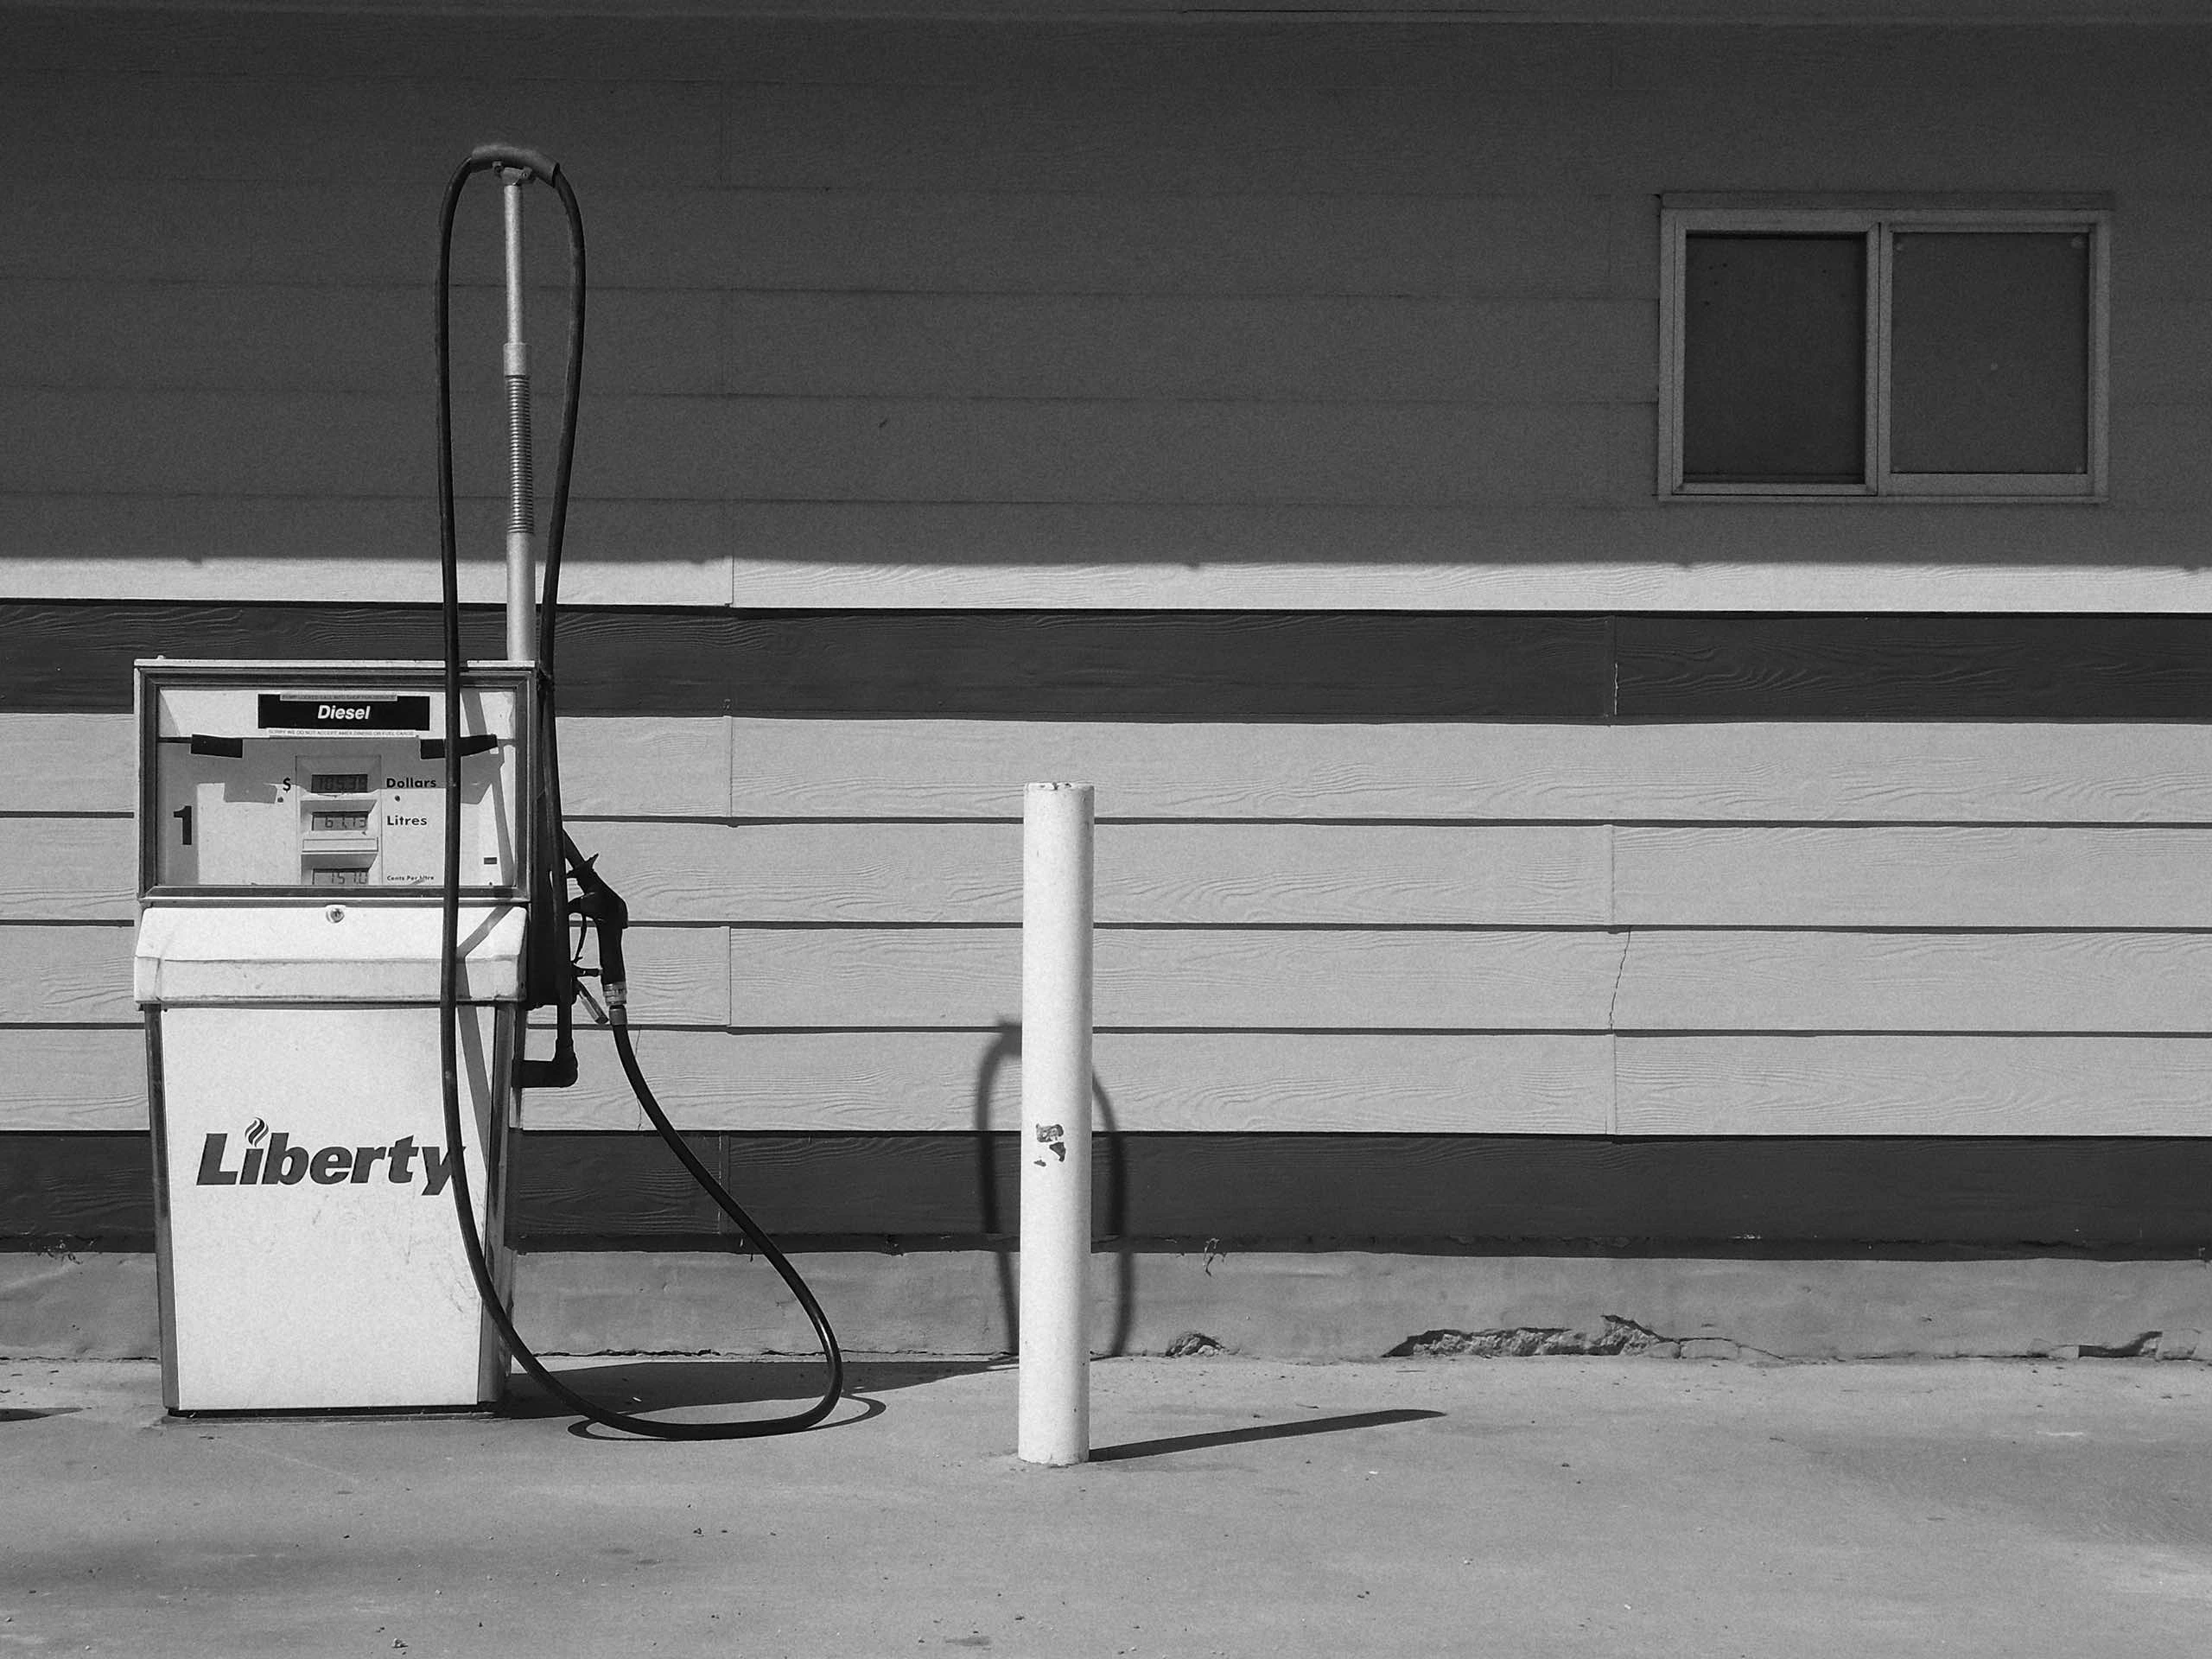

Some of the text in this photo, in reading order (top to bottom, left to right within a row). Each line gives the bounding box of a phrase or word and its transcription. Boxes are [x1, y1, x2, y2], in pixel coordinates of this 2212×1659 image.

[317, 705, 371, 720] Diesel
[283, 777, 292, 792] $
[386, 778, 437, 788] Dollars
[174, 806, 193, 846] 1
[386, 815, 428, 826] Litres
[197, 1132, 465, 1196] Liberty
